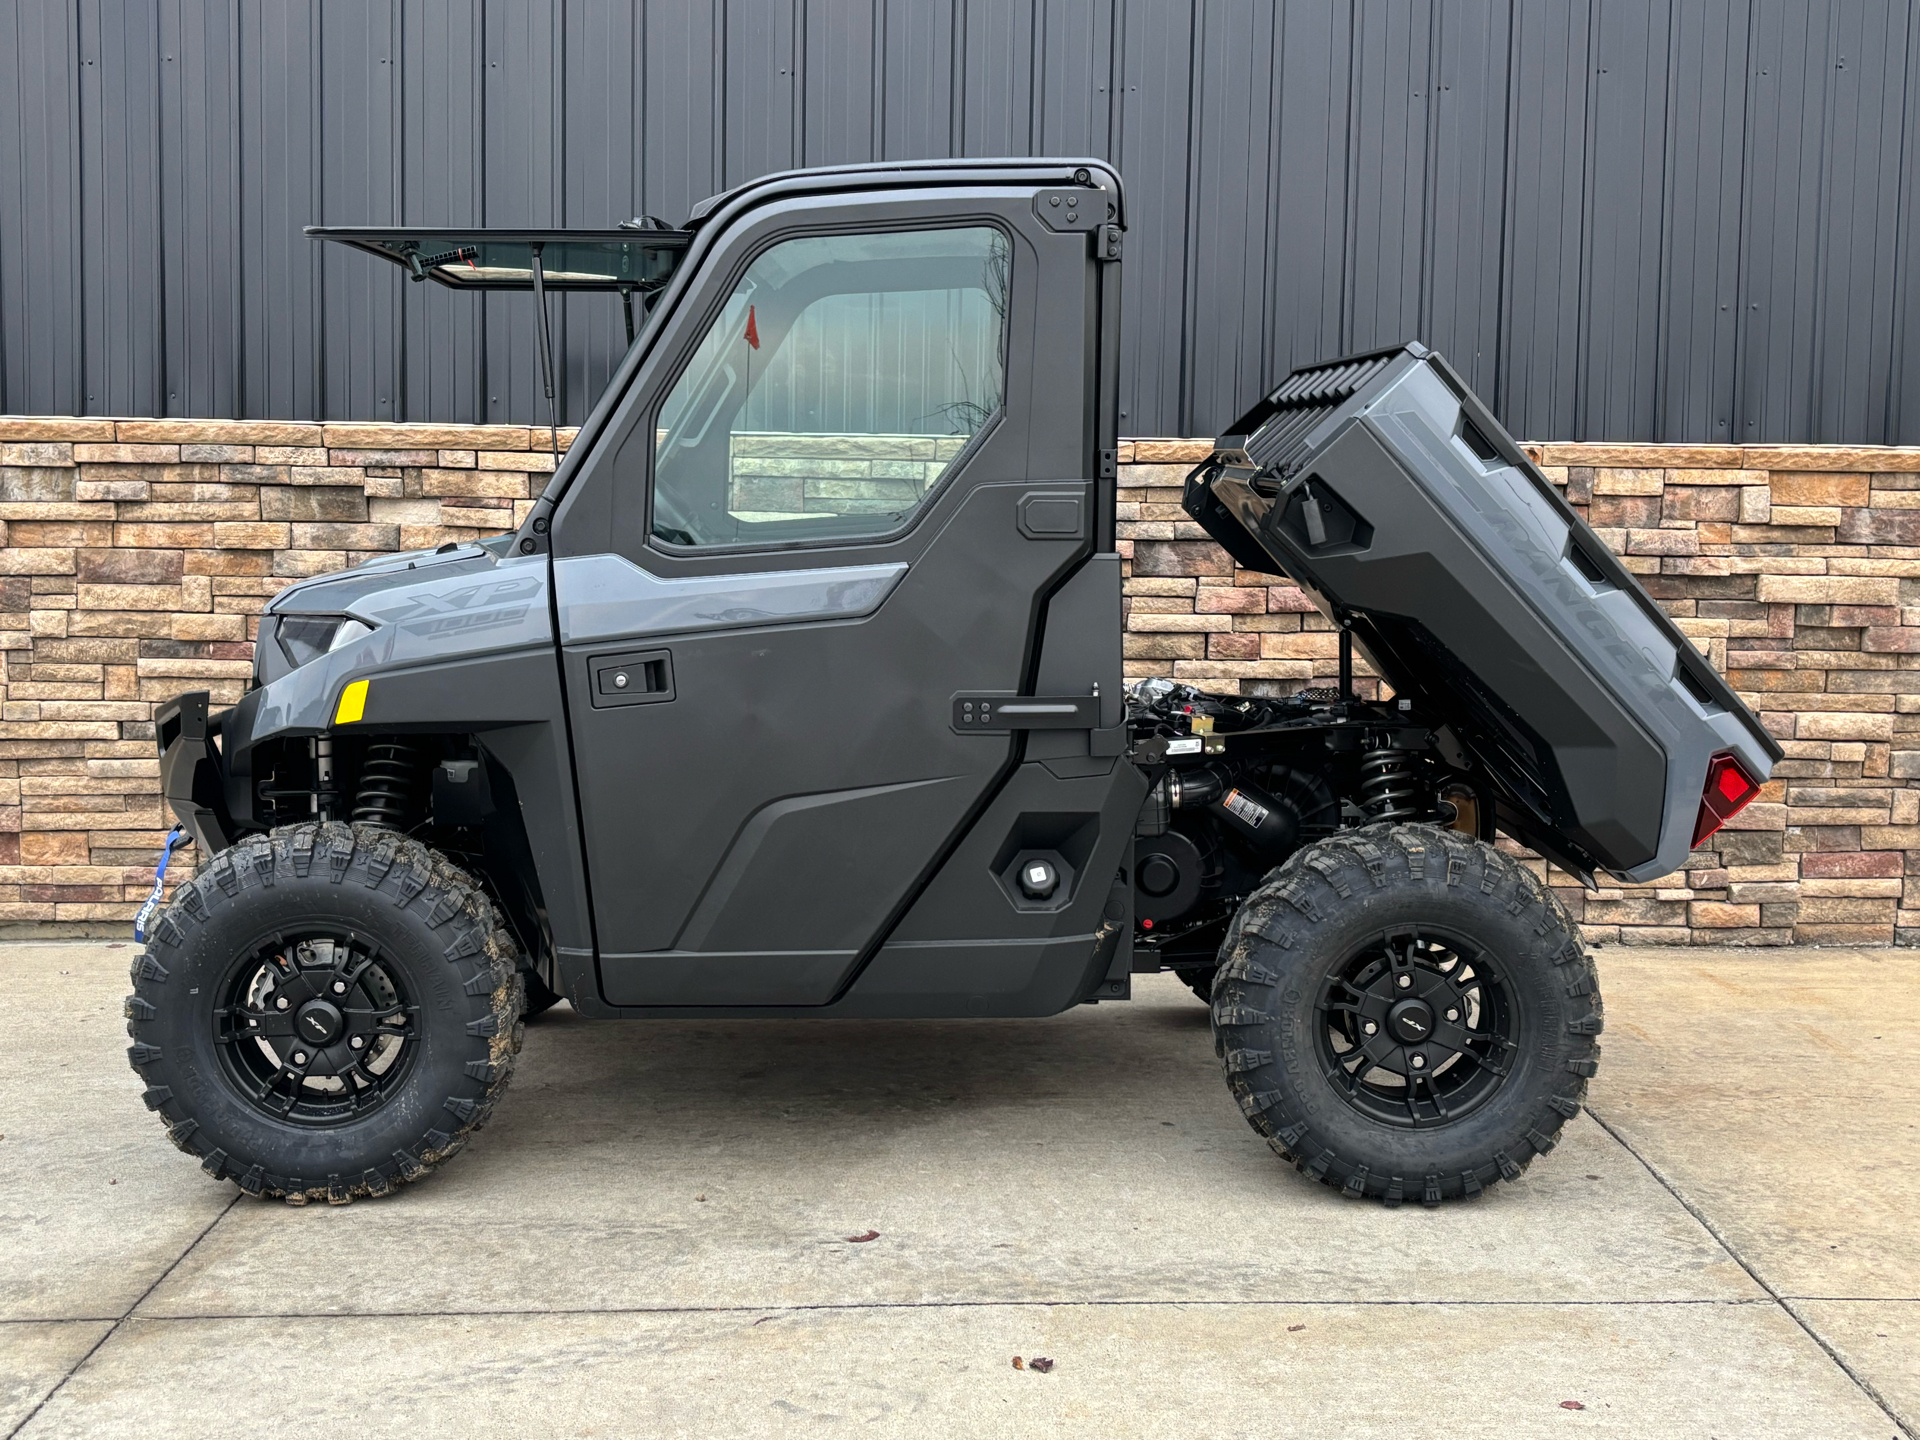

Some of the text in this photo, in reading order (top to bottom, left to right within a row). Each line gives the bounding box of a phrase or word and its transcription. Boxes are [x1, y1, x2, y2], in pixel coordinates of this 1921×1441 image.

[395, 576, 541, 620] XP
[1481, 510, 1677, 704] RANGER
[428, 605, 530, 633] 1000
[136, 876, 163, 932] POLARIS
[305, 1016, 327, 1034] XP
[1402, 1017, 1426, 1031] XP
